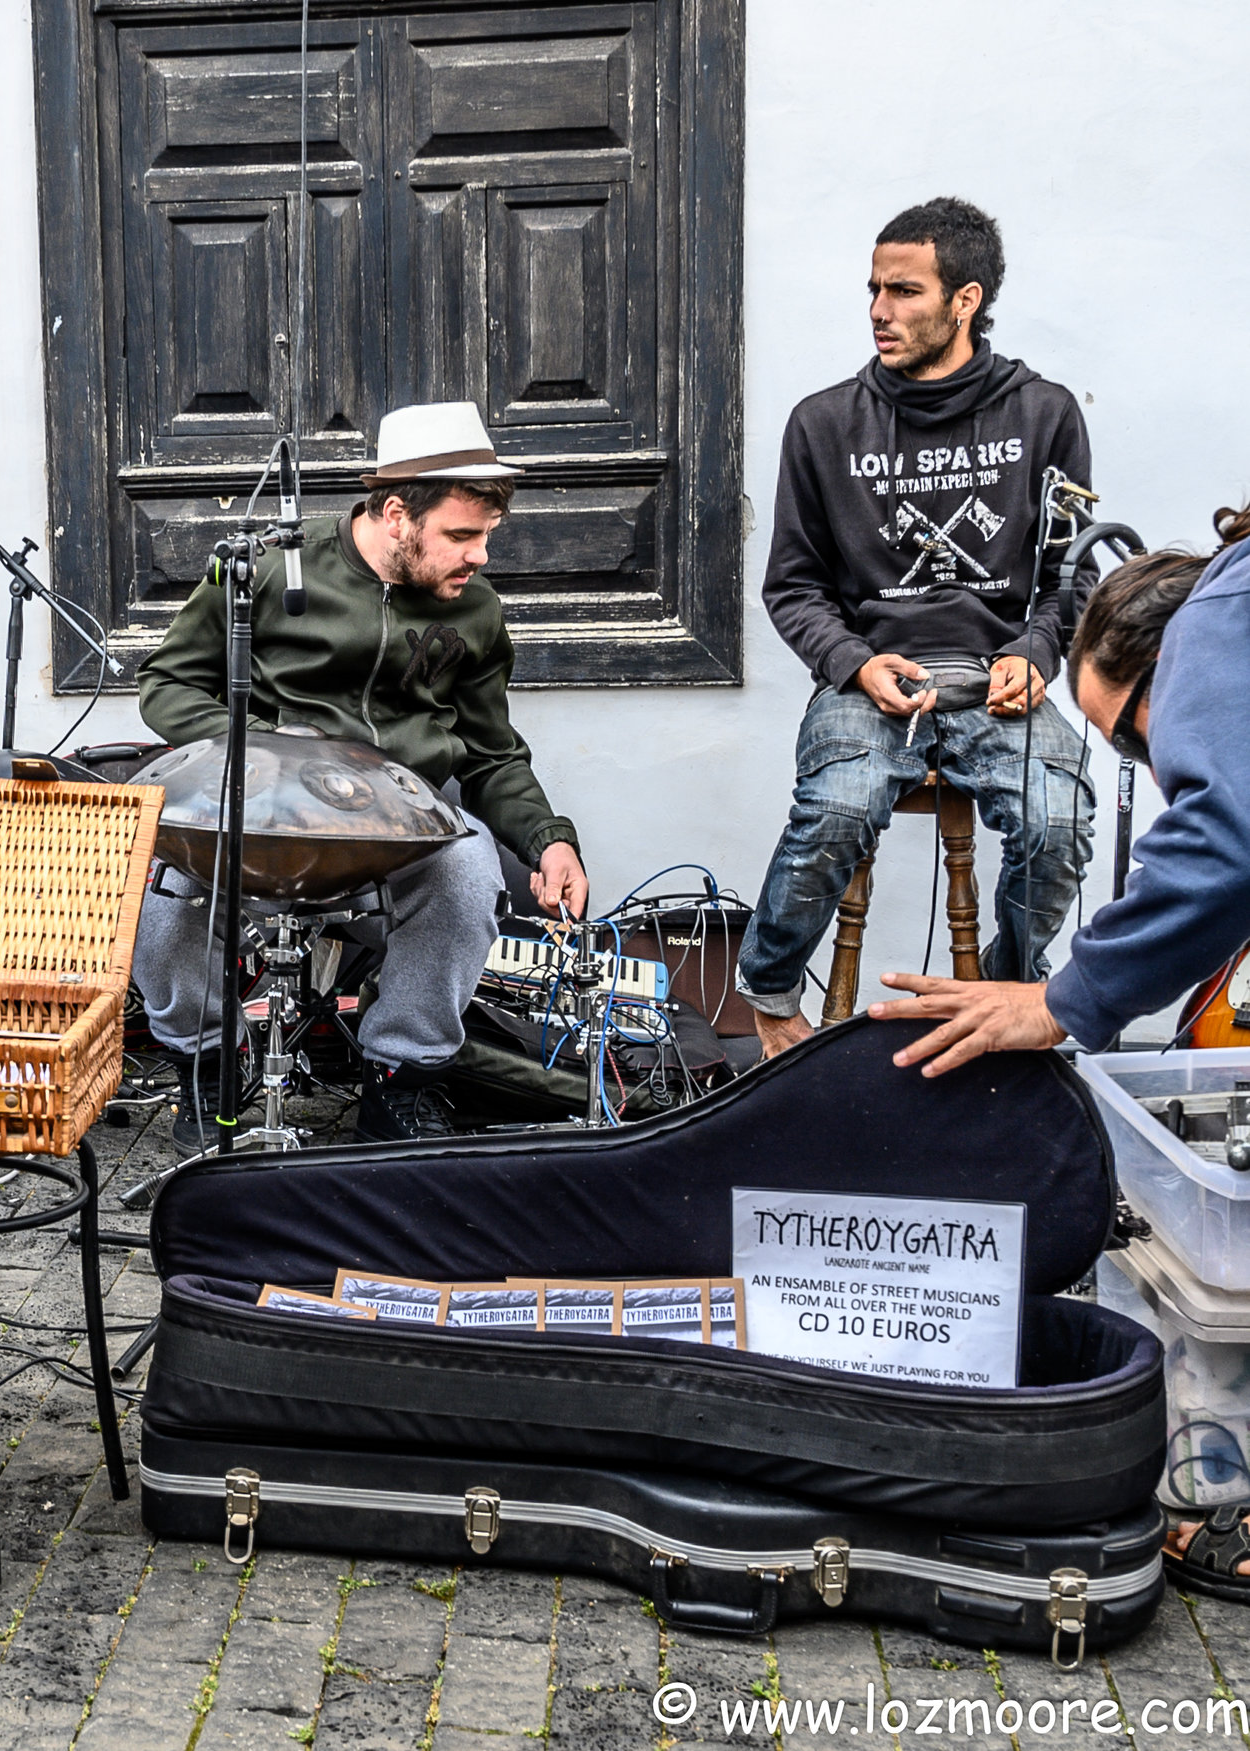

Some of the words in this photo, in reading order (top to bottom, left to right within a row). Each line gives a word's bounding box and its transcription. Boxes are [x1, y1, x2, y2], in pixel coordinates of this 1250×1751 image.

[916, 438, 1023, 473] SPARKS
[667, 936, 702, 946] Roland
[753, 1210, 1000, 1262] TYTHEROYGATRA
[872, 1260, 906, 1273] ANCIENT
[908, 1263, 931, 1274] NAME
[752, 1274, 771, 1287] AN
[775, 1275, 846, 1294] ENSAMBLE
[850, 1281, 869, 1295] OF
[872, 1283, 918, 1300] STREET
[923, 1288, 1000, 1307] MUSICIANS
[463, 1308, 535, 1324] TYTHEROYGATRA
[626, 1305, 698, 1322] TYTHEROYGATRA
[781, 1292, 819, 1307] FROM
[824, 1295, 847, 1310] ALL
[851, 1298, 886, 1314] OVER
[891, 1302, 916, 1316] THE
[920, 1304, 972, 1320] WORLD
[799, 1312, 829, 1333] CD
[837, 1315, 865, 1336] 10
[872, 1318, 951, 1344] EUROS
[851, 1361, 867, 1372] WE
[870, 1363, 894, 1374] JUST
[898, 1365, 940, 1379] PLAYING
[943, 1370, 964, 1381] FOR
[967, 1372, 990, 1383] YOU
